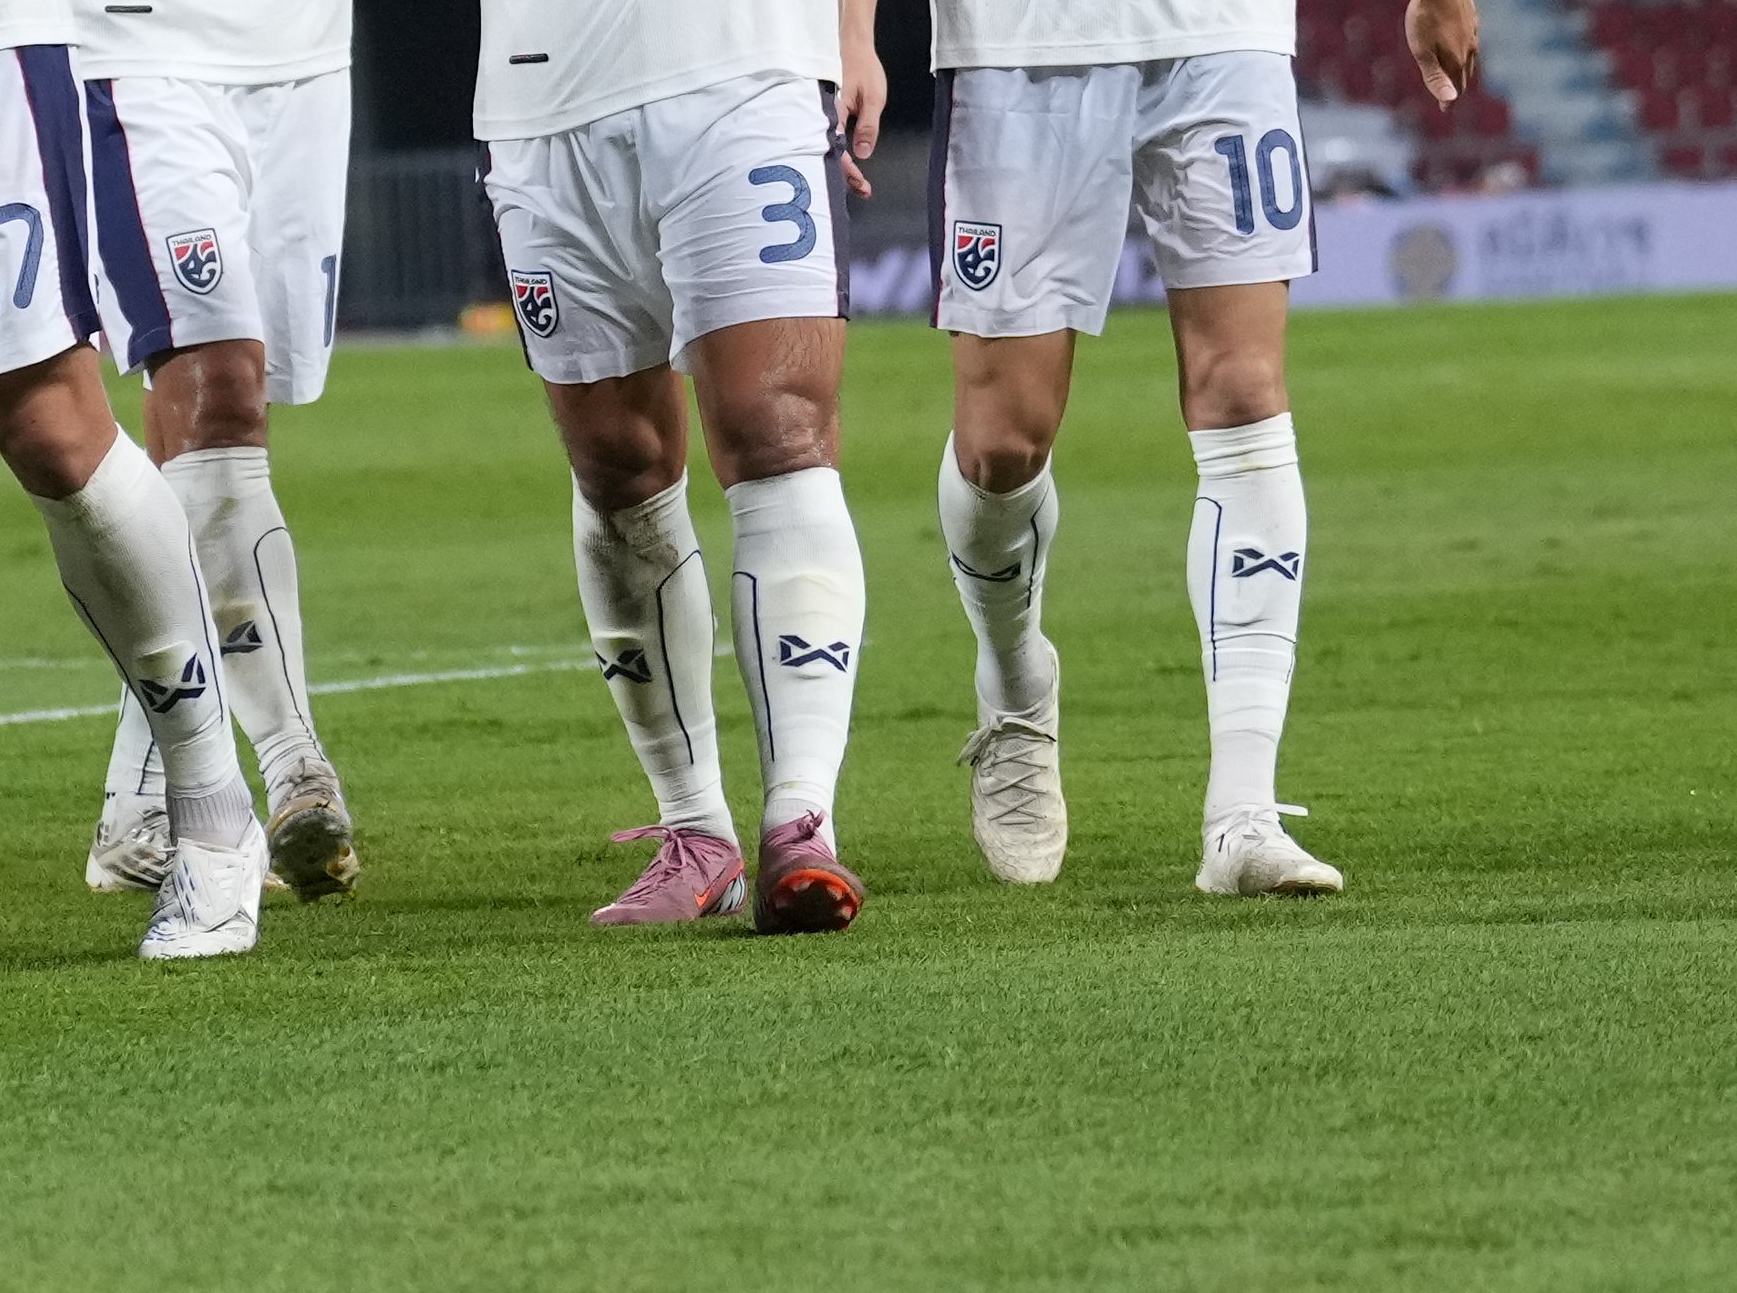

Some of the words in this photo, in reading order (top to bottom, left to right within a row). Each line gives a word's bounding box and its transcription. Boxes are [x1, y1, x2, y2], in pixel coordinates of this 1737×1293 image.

[1213, 128, 1303, 235] 10
[172, 234, 212, 247] THAILAND
[747, 163, 817, 264] 3
[958, 226, 997, 237] THAILAND
